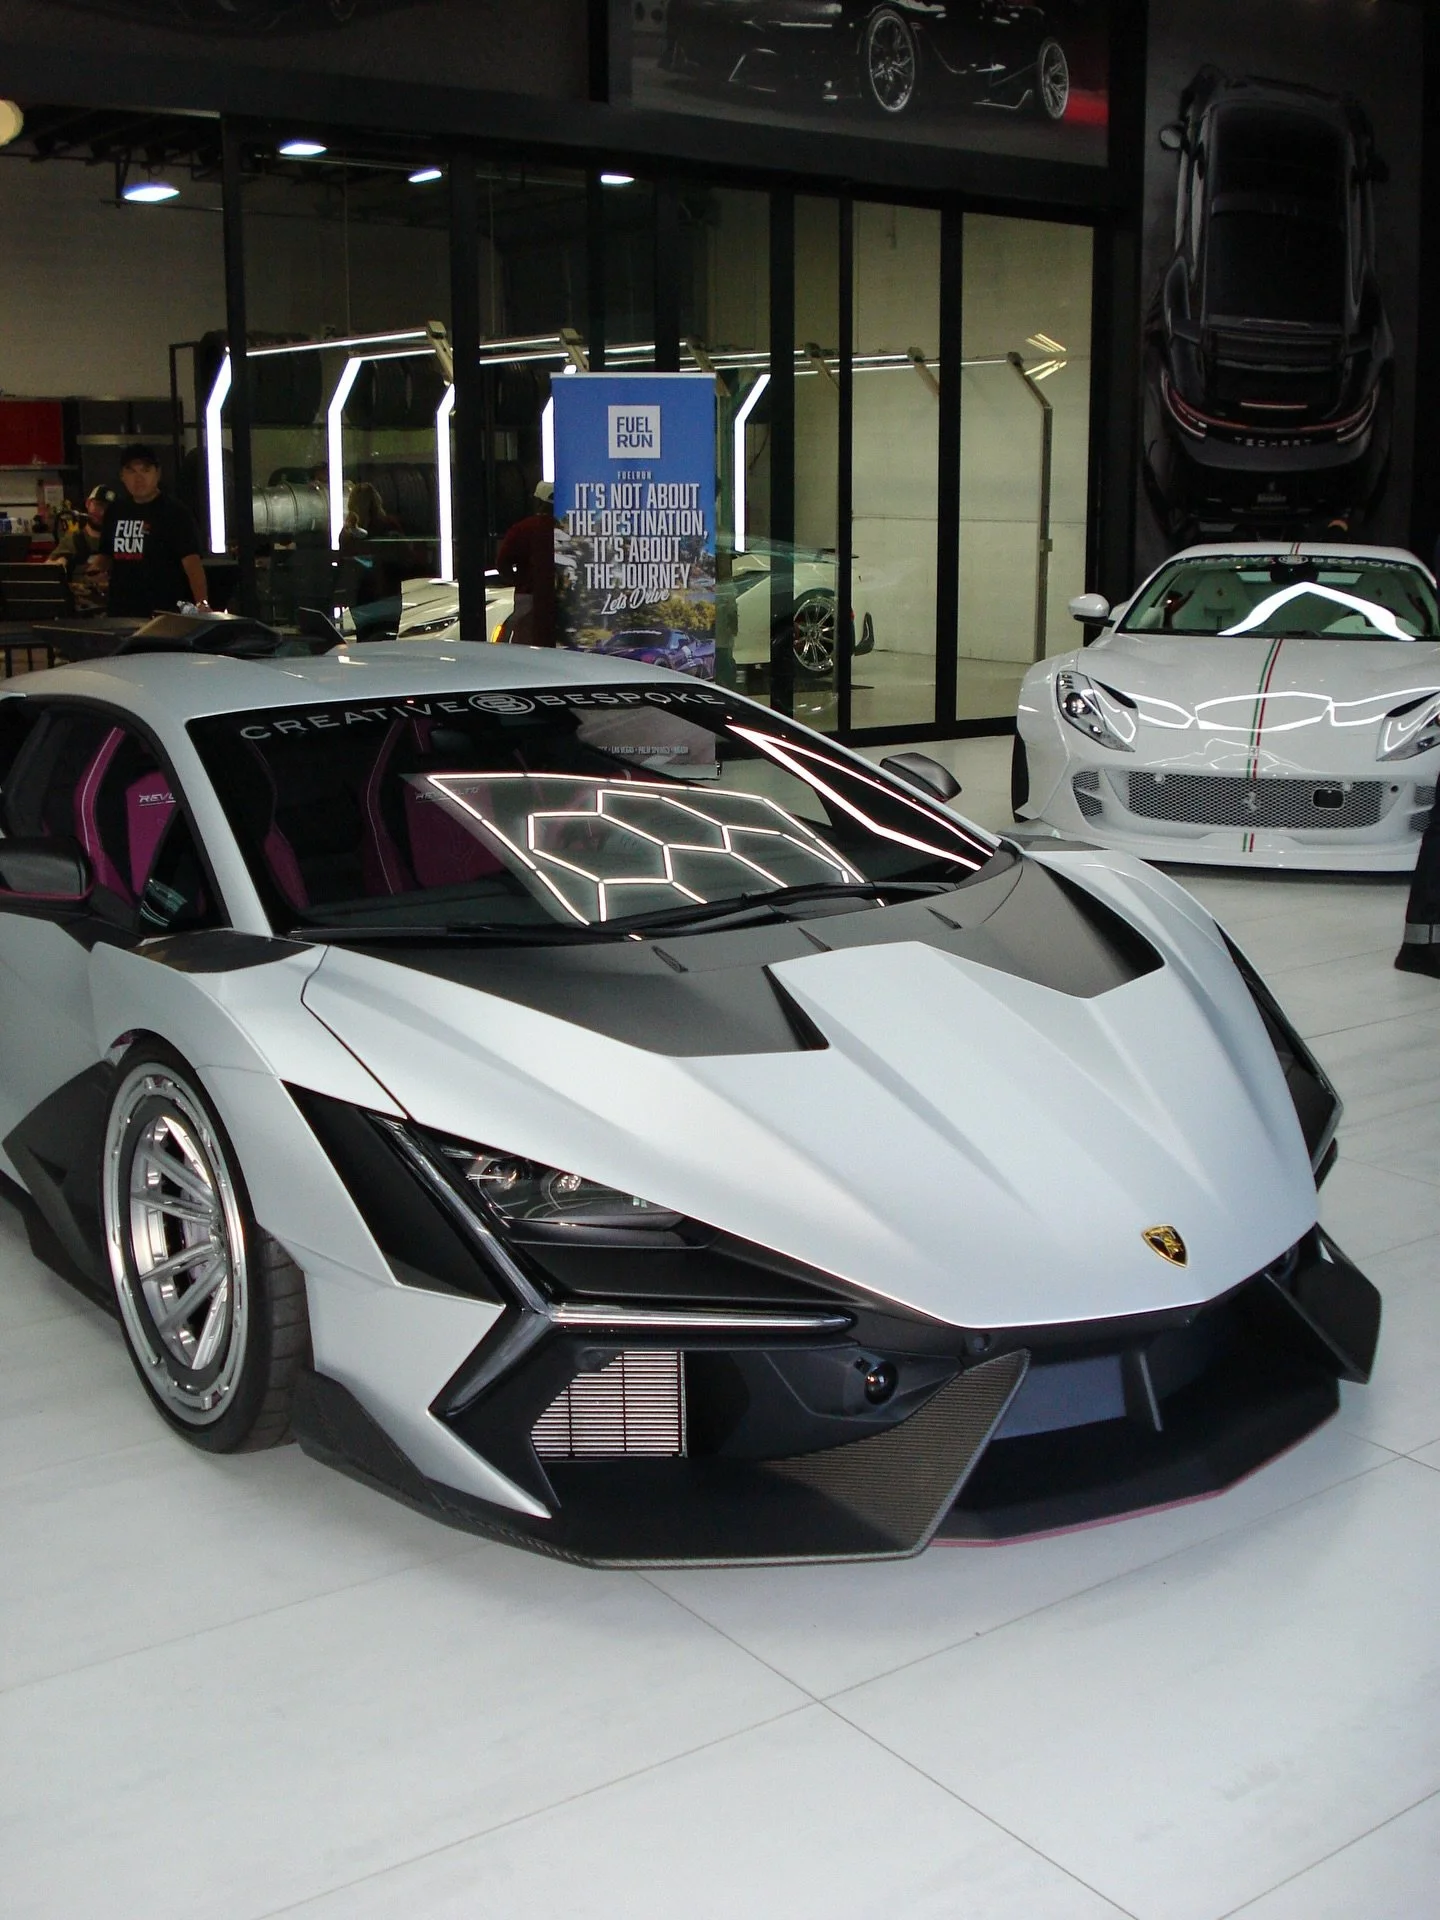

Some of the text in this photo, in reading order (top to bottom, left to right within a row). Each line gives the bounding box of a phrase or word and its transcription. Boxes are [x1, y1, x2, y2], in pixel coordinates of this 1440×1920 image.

[617, 416, 653, 433] FUEL
[617, 434, 653, 448] RUN
[617, 471, 652, 480] FUELRUN
[575, 483, 700, 509] IT'S NOT ABOUT
[115, 519, 145, 538] FUEL
[566, 510, 708, 539] THE DESTINATION,
[113, 537, 144, 553] RUN
[593, 537, 681, 562] IT'S ABOUT
[1312, 557, 1410, 572] BESPOKE
[585, 563, 691, 589] THE JOURNEY
[629, 587, 670, 609] Drive
[239, 692, 726, 740] CREATIVE BESPOKE
